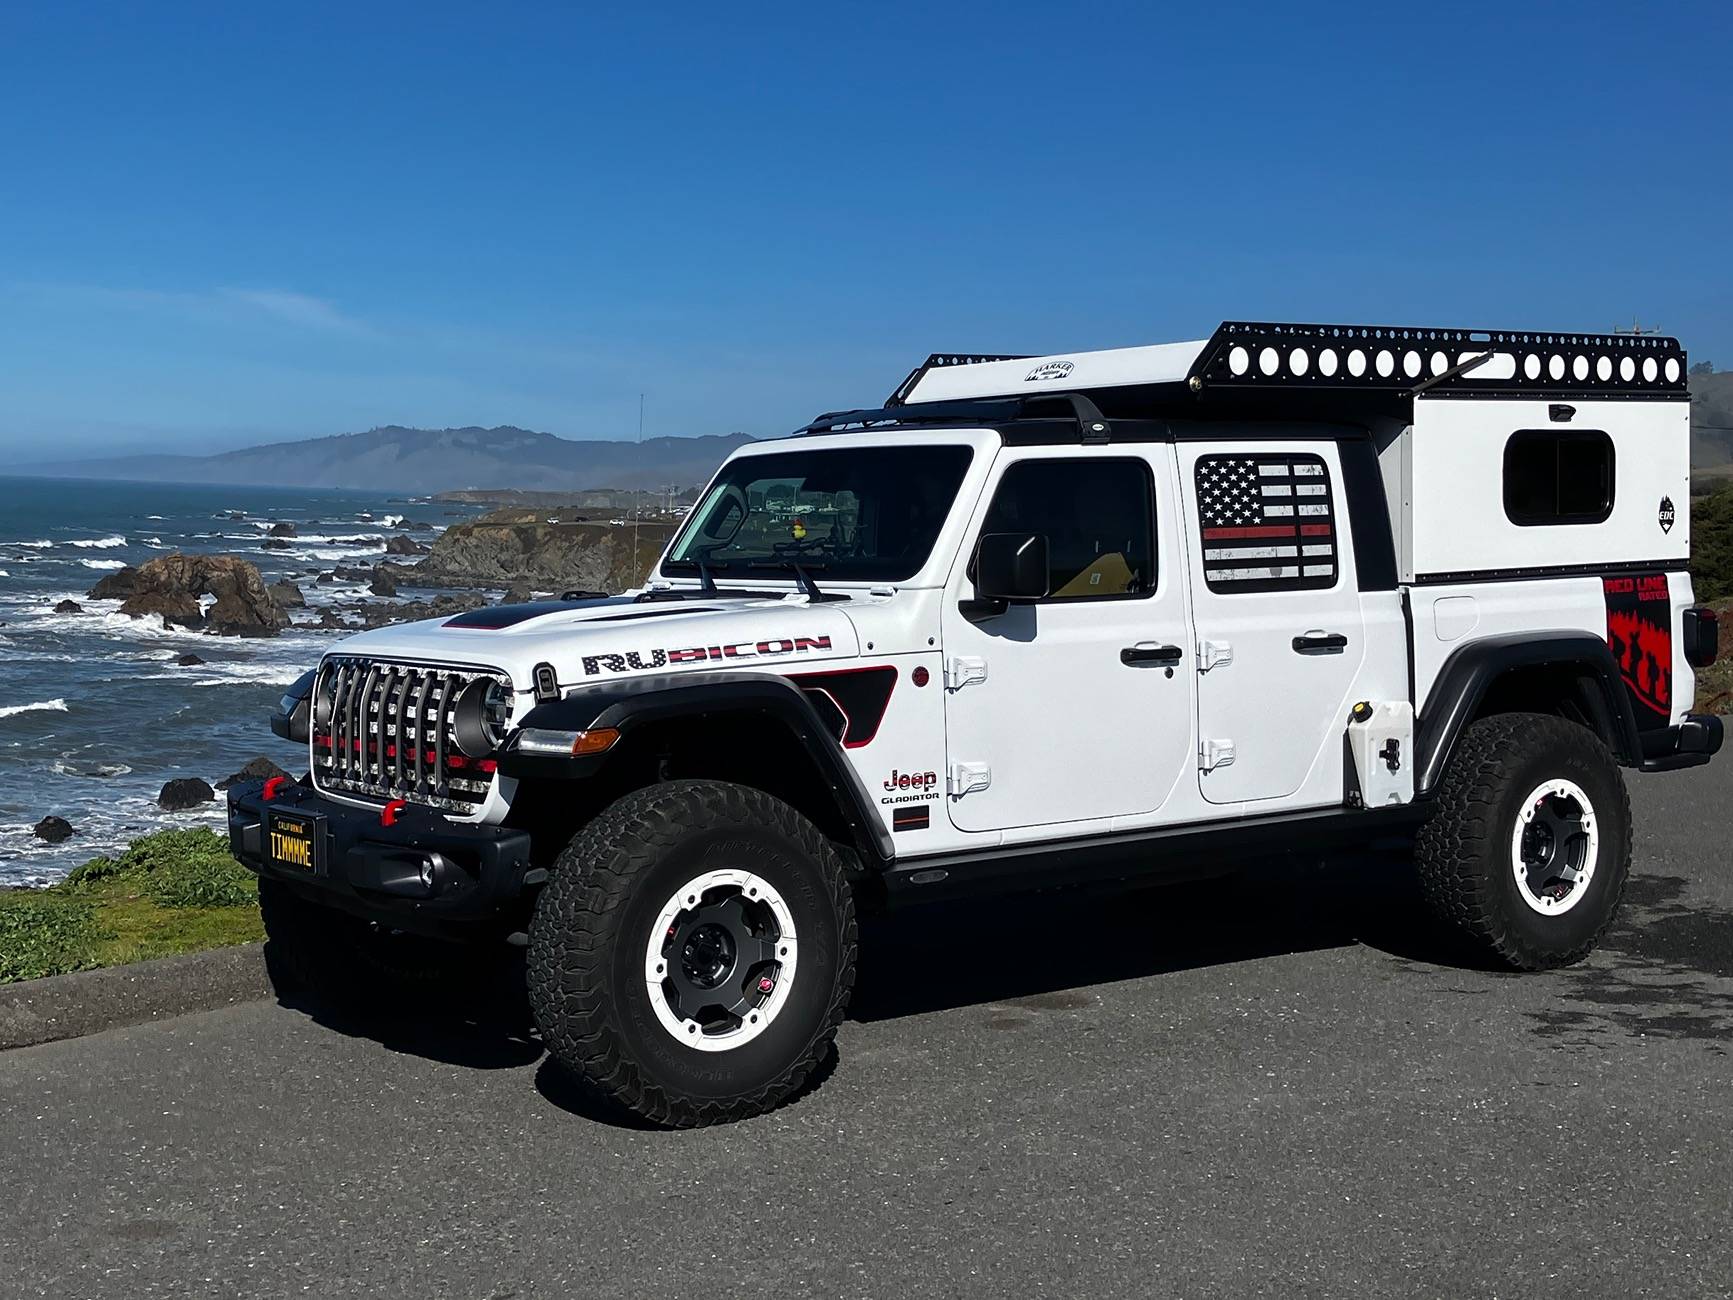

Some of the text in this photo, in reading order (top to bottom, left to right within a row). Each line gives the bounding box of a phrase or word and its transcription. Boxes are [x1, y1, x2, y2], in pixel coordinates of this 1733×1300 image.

[1659, 511, 1674, 520] EDC
[1604, 575, 1666, 593] RED LINE
[581, 635, 832, 676] RUBICON
[883, 769, 937, 792] Jeep
[881, 792, 940, 805] GLADIATOR
[278, 820, 303, 834] CALIFORNIA
